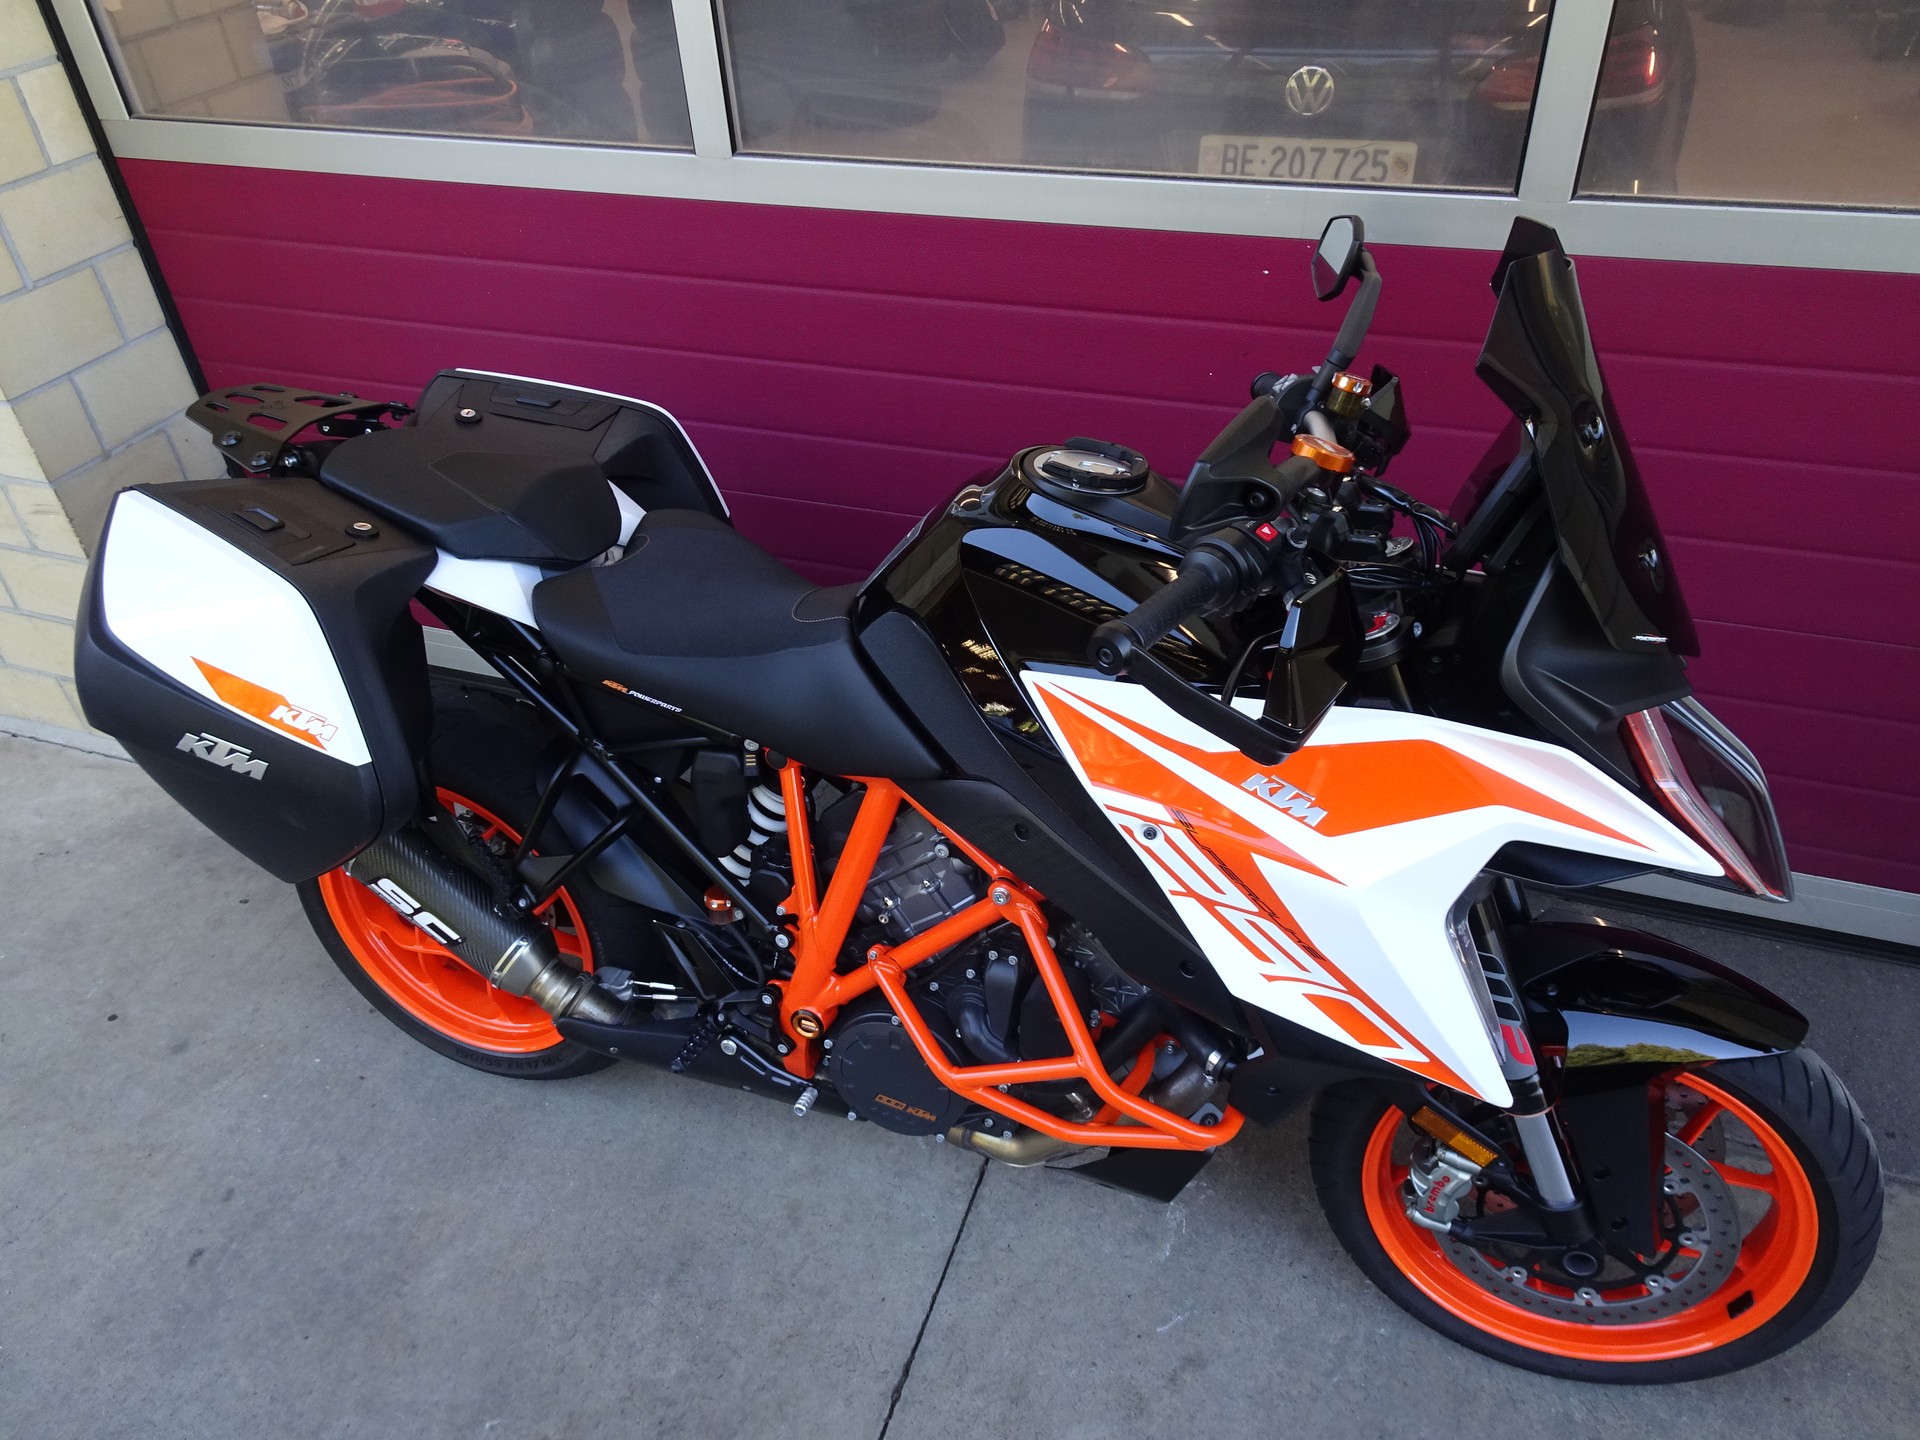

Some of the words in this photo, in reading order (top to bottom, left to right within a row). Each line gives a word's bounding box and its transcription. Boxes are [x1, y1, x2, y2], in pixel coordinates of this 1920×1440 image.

[1285, 66, 1335, 116] VW
[269, 704, 339, 742] KTM
[629, 690, 683, 713] POWERPARTS
[176, 732, 270, 781] KTM
[1240, 772, 1329, 828] KTM
[1423, 1175, 1451, 1213] brembo
